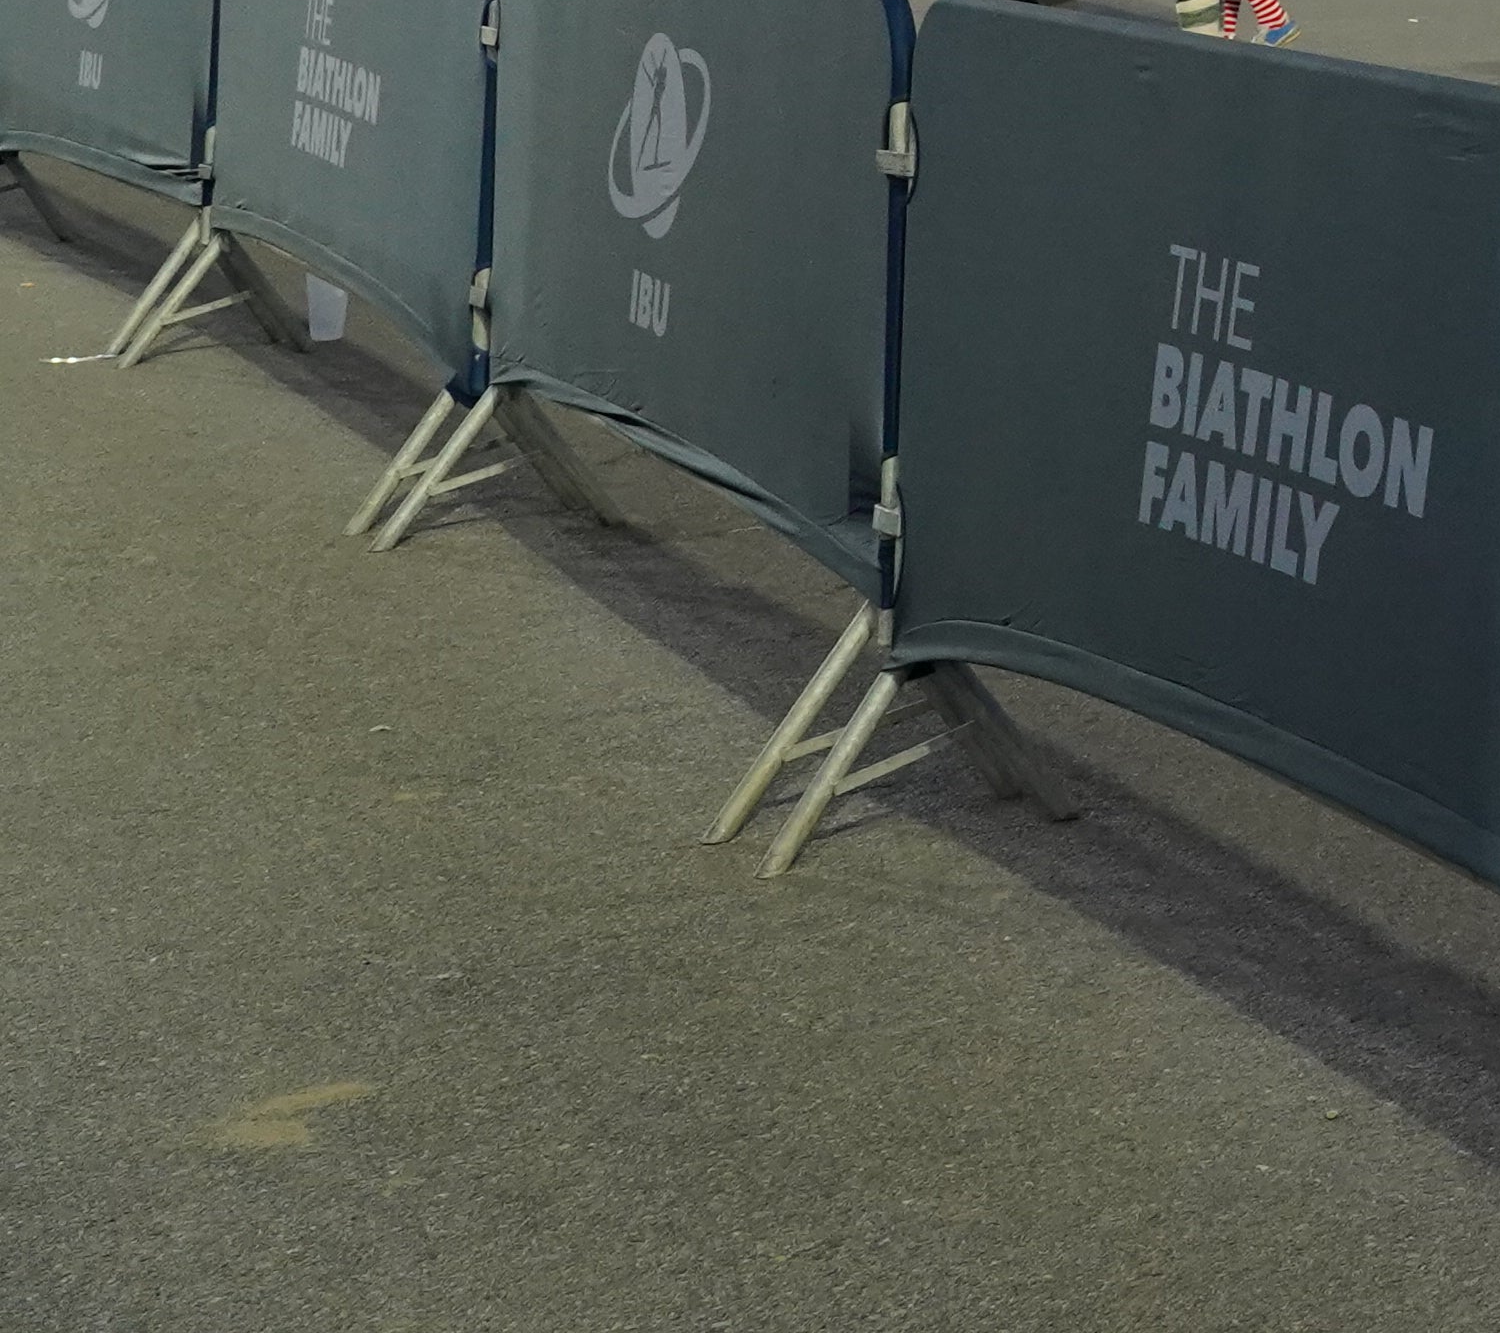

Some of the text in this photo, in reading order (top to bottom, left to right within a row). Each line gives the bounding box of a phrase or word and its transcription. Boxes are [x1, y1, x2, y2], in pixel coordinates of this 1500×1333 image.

[78, 48, 103, 91] IBU
[296, 45, 381, 126] BIATHLON
[291, 98, 354, 169] FAMILY
[628, 267, 673, 338] IBU
[1167, 243, 1261, 352] THE
[1149, 341, 1434, 519] BIATHLON
[1138, 440, 1341, 586] FAMILY
